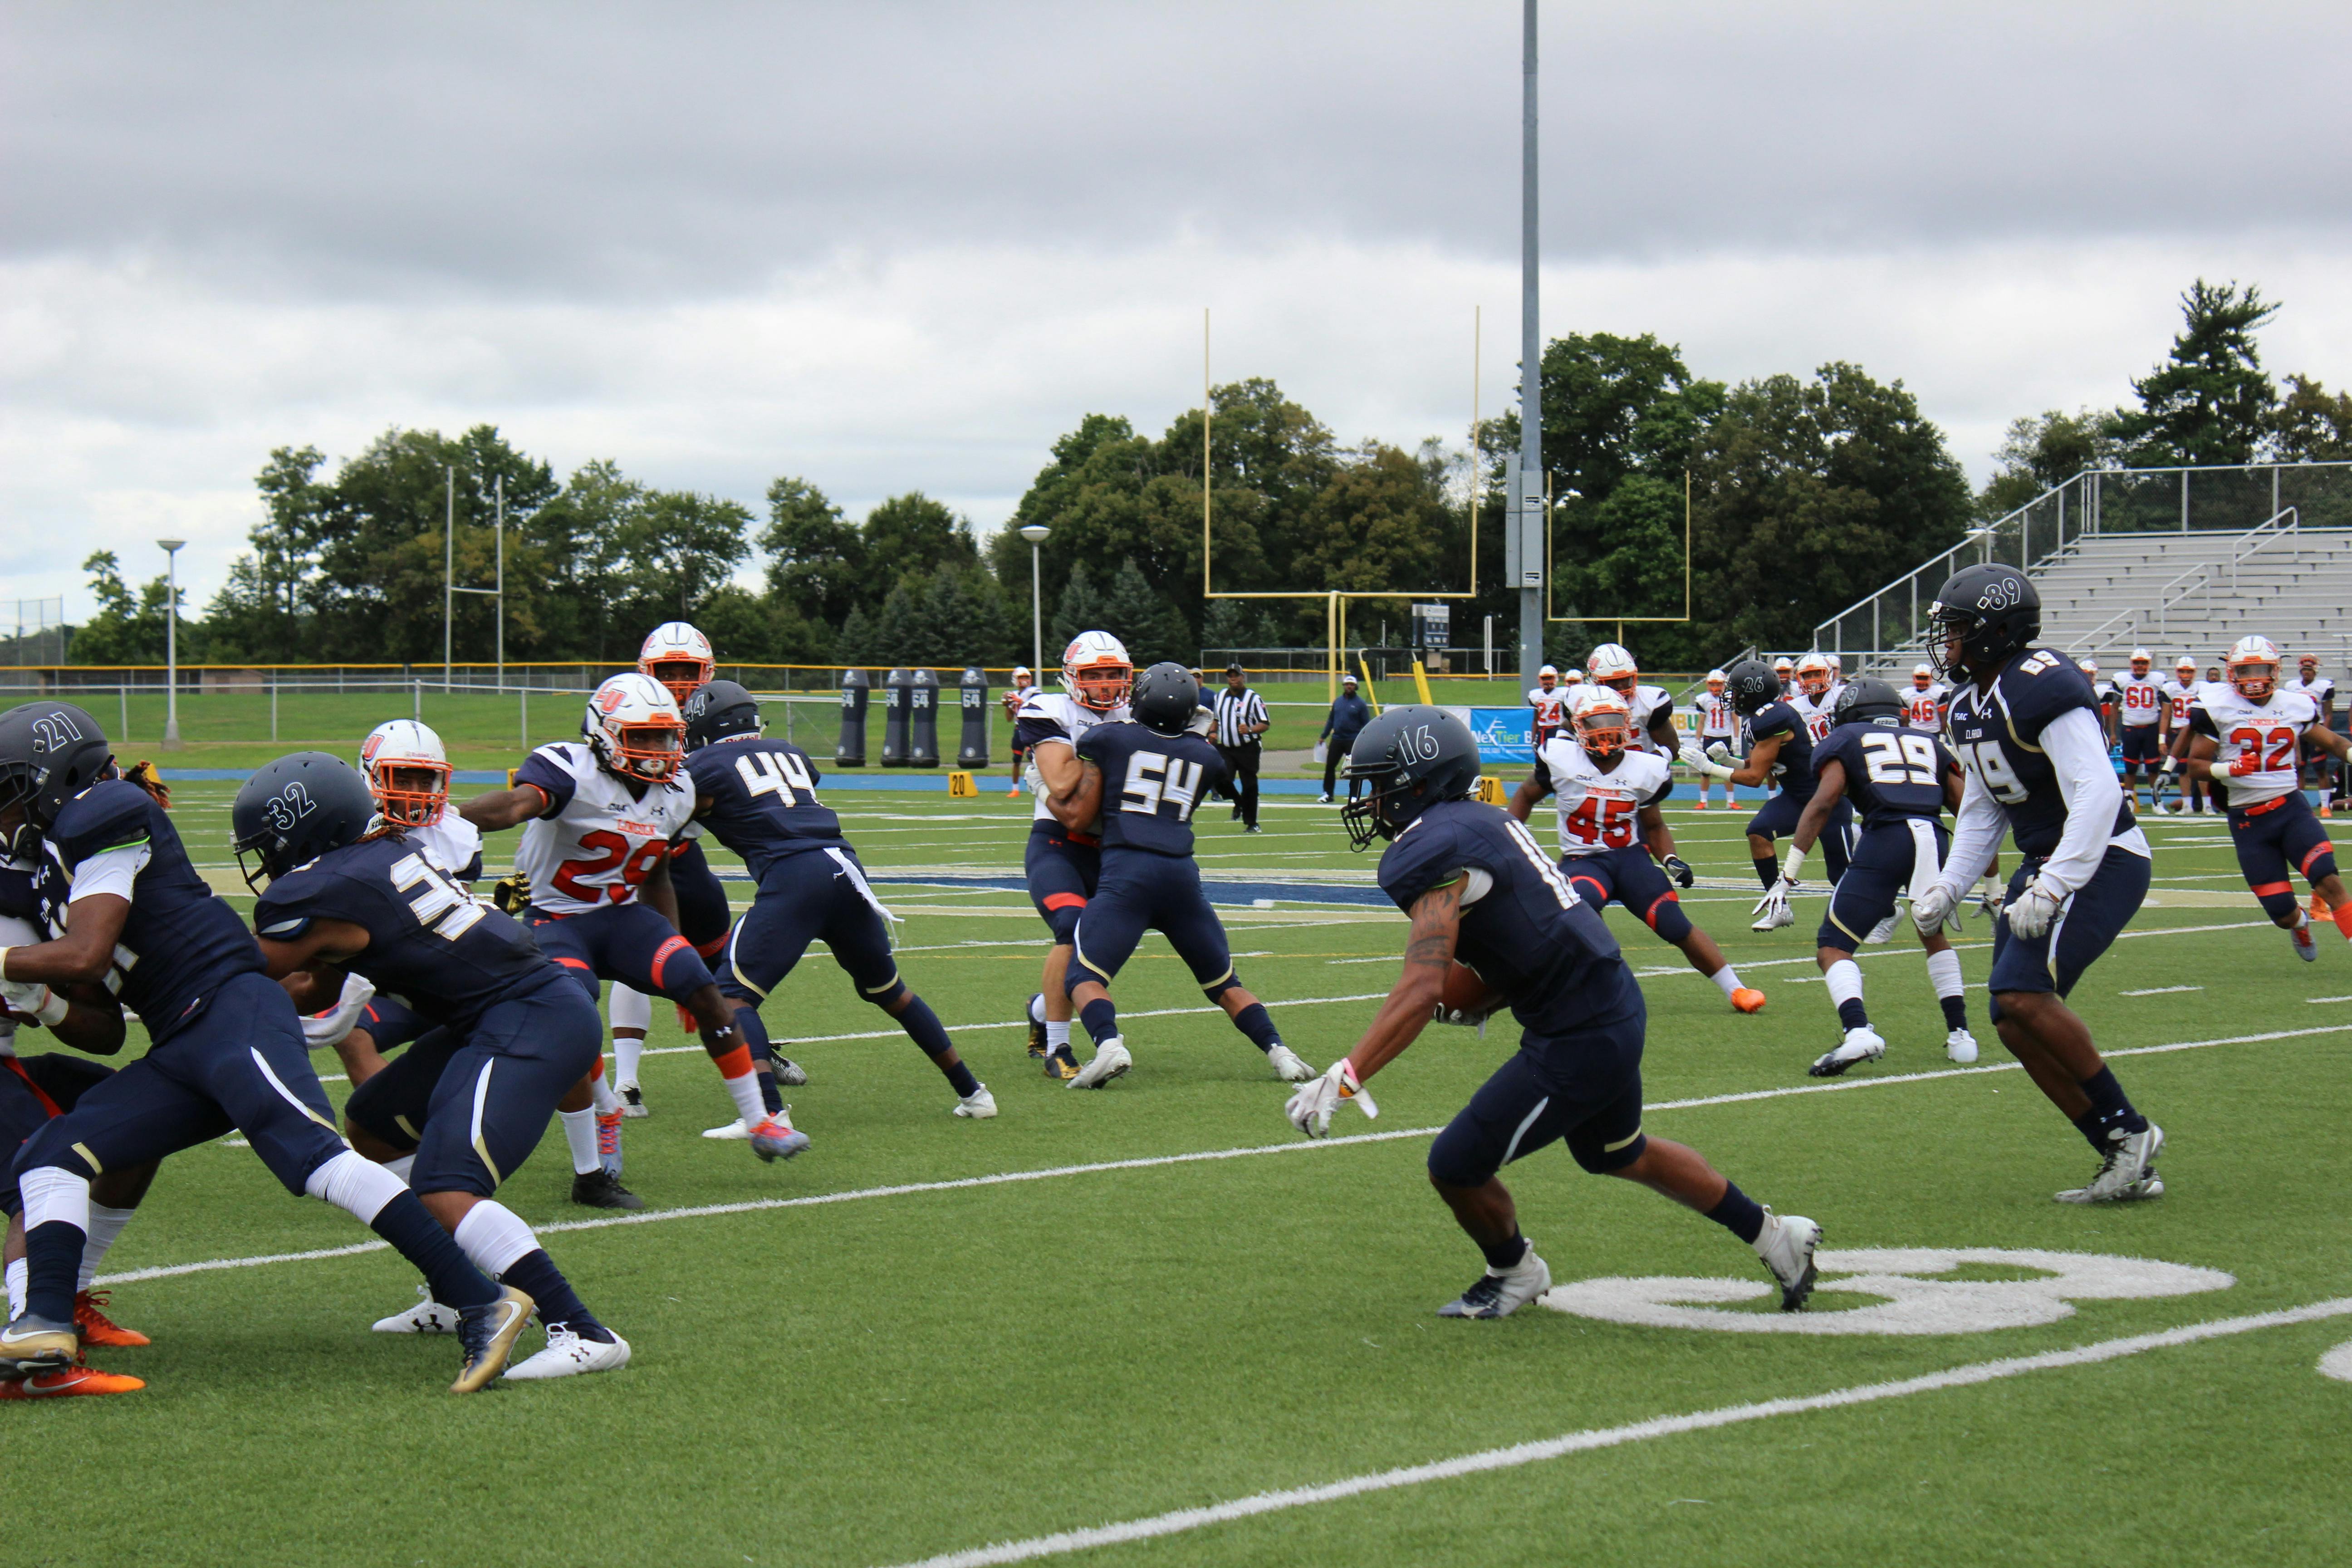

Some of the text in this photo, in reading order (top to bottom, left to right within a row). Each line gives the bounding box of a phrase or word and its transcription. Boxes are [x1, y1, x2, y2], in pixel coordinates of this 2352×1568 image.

[1985, 577, 2021, 611] 89
[2019, 650, 2061, 676] 89
[1744, 676, 1764, 693] 26
[2126, 686, 2154, 709] 60
[684, 694, 706, 723] 44
[912, 694, 929, 708] 64
[962, 694, 980, 708] 64
[1838, 686, 1859, 712] 29
[1911, 700, 1935, 722] 46
[1536, 702, 1560, 723] 24
[1710, 707, 1724, 729] 11
[33, 711, 84, 754] 21
[1399, 725, 1440, 766] 16
[1471, 730, 1521, 744] NexTier
[1861, 732, 1940, 786] 29
[2230, 727, 2294, 772] 32
[735, 751, 818, 808] 44
[953, 774, 965, 795] 20
[1119, 750, 1204, 822] 54
[1480, 779, 1493, 803] 30
[267, 781, 317, 830] 32
[1566, 797, 1637, 849] 45
